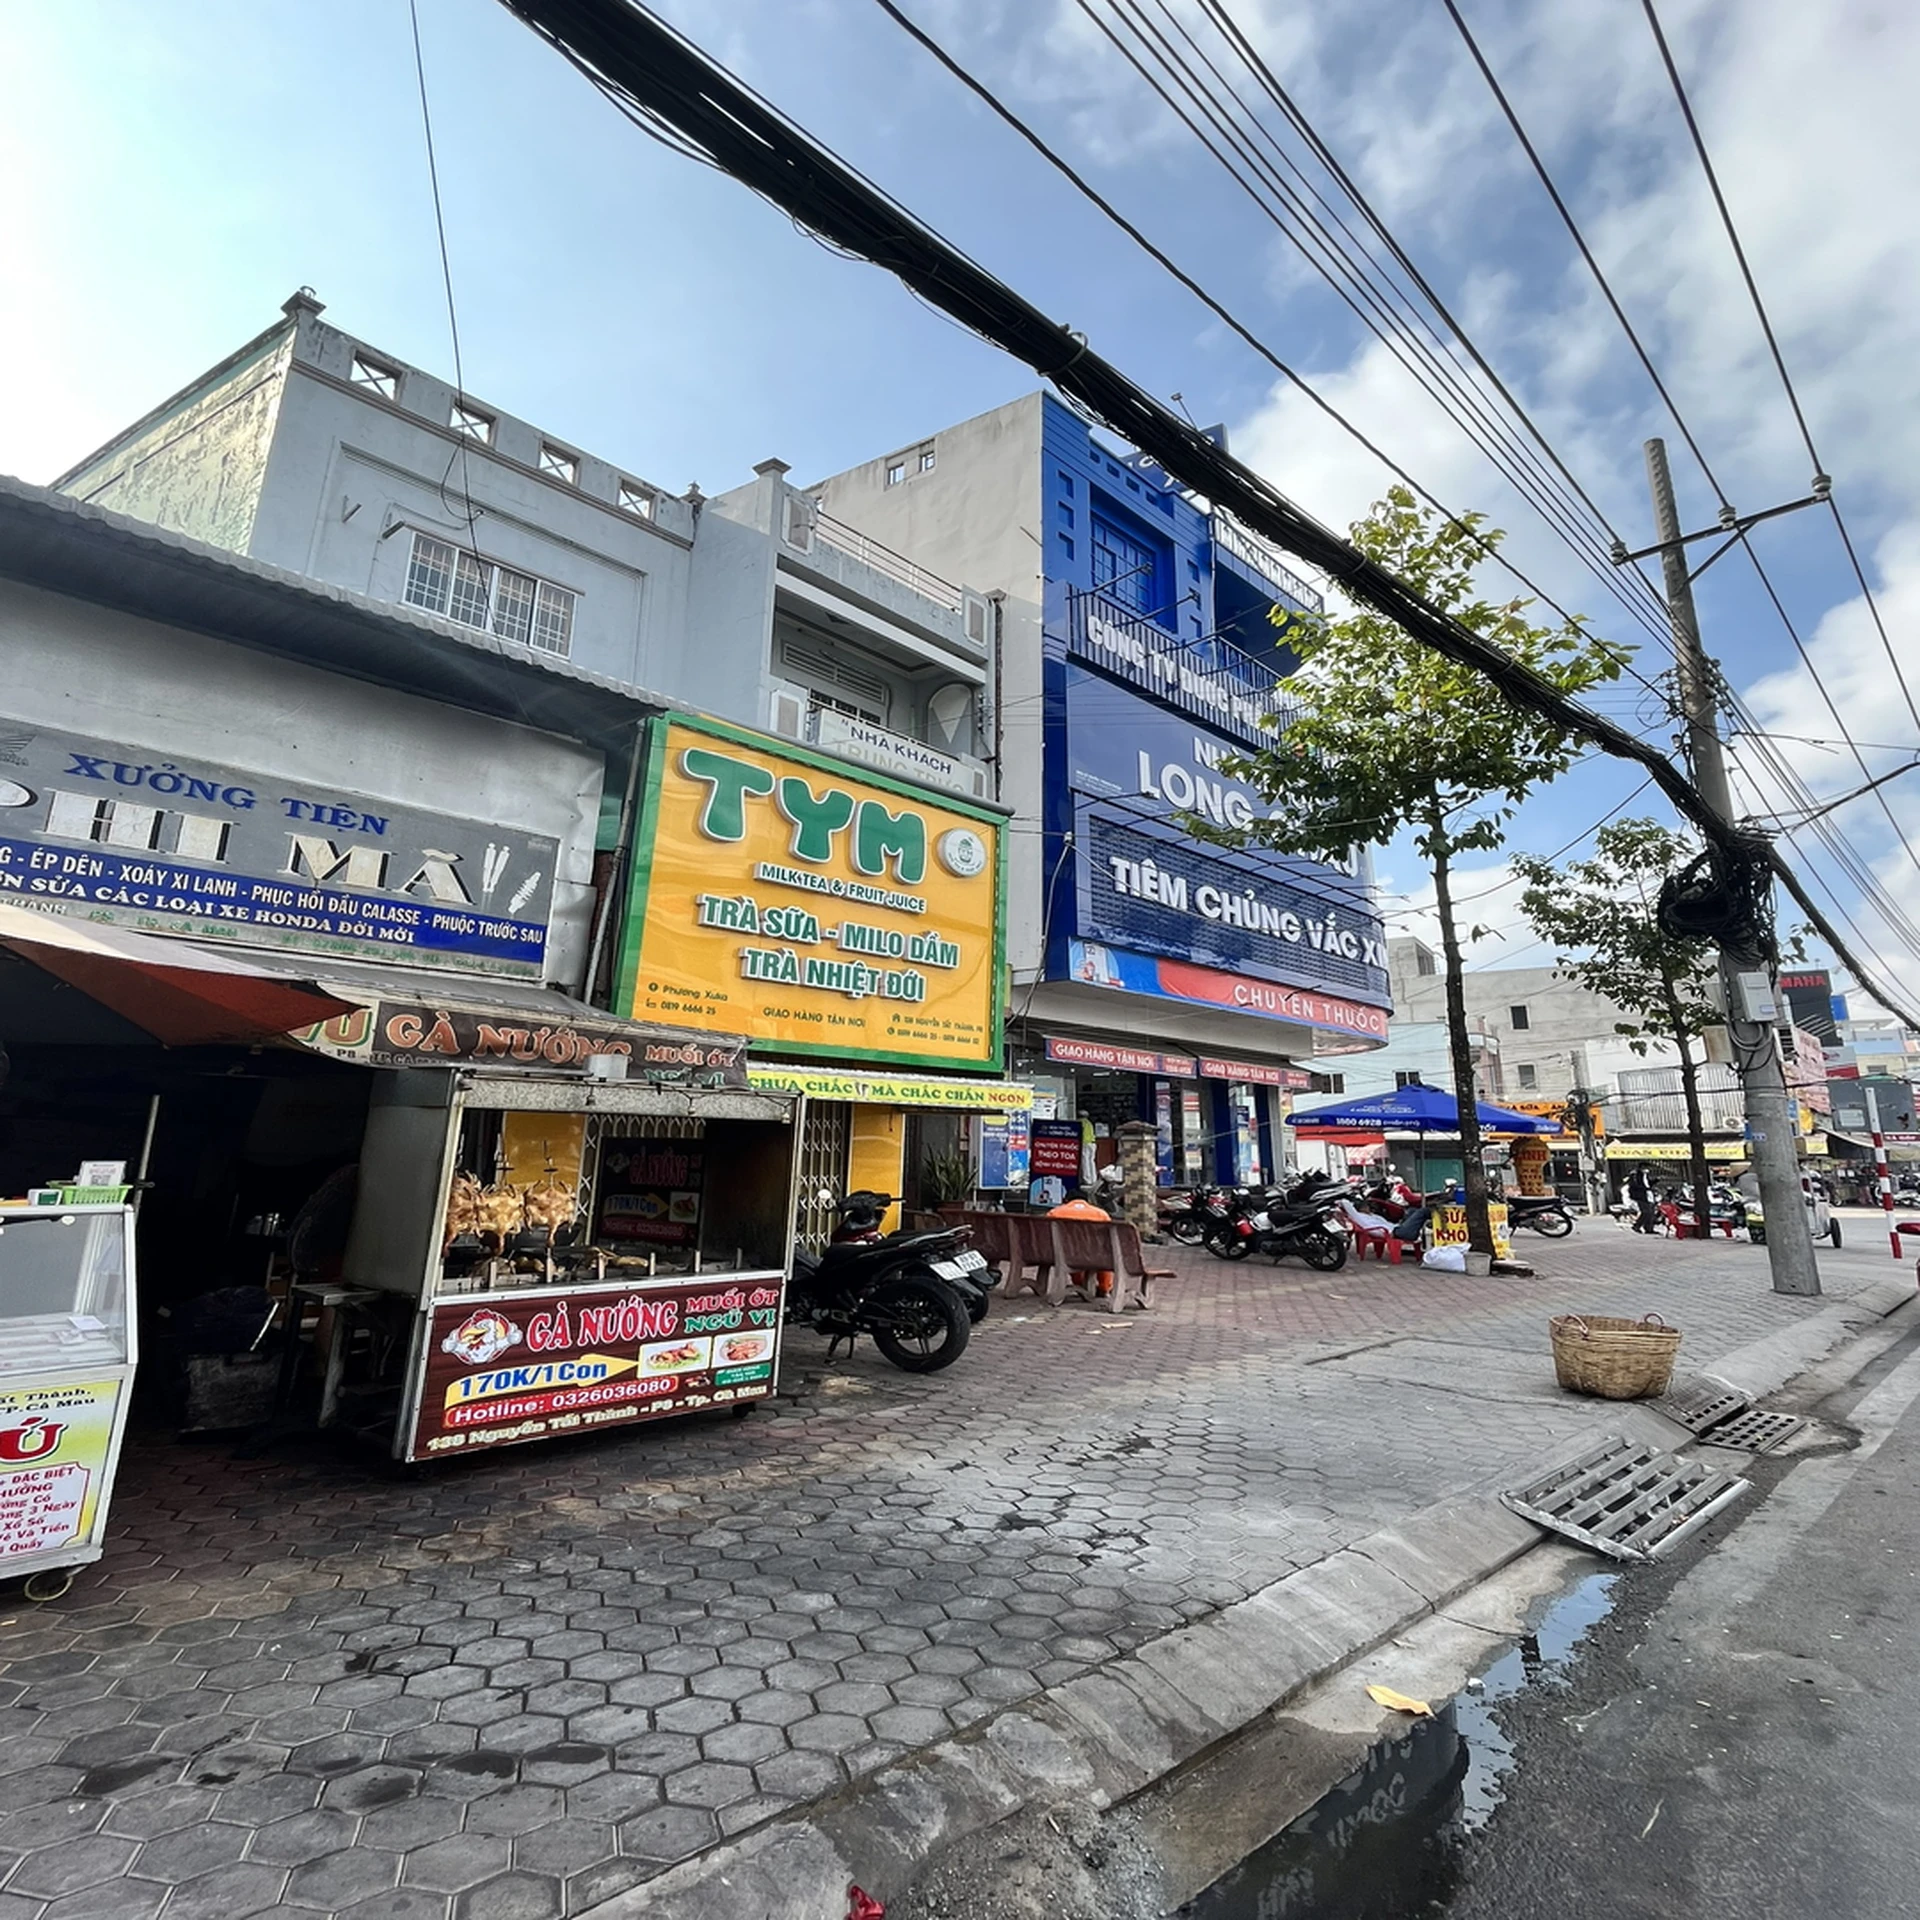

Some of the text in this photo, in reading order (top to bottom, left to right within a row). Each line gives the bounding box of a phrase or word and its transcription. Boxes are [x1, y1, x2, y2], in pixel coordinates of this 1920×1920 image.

[63, 752, 390, 835] XƯỞNG TIỆN
[680, 746, 927, 885] TYM
[1138, 749, 1254, 829] LONG
[30, 847, 58, 872] ÉP
[120, 863, 169, 887] XOÁY
[170, 872, 190, 892] XI
[193, 875, 237, 899] LANH
[251, 885, 294, 910] PHỤC
[361, 903, 420, 927] CALASSE
[432, 914, 476, 937] PHUỘC
[520, 927, 544, 944] SAU
[276, 831, 478, 906] MÃ
[832, 880, 843, 893] &
[848, 884, 886, 902] FRUIT
[887, 894, 925, 912] JUICE
[29, 874, 87, 898] SỬA
[95, 883, 150, 906] CÁC
[155, 895, 215, 918] LOẠI
[216, 904, 249, 920] XE
[254, 910, 333, 932] HONDA
[337, 920, 374, 938] ĐỜI
[379, 925, 415, 943] MỚI
[699, 892, 960, 968] TRÀ SỮA MILO DẦM
[1109, 856, 1188, 911] TIÊM
[1195, 886, 1300, 943] CHỦNG
[1304, 911, 1359, 960] VẮC
[743, 946, 926, 1001] TRÀ NHIỆT ĐỚI
[762, 1007, 791, 1019] GIAO
[793, 1010, 823, 1023] HÀNG
[827, 1013, 846, 1027] TẬN
[1233, 984, 1381, 1032] CHUYÊN THUỐC
[384, 1011, 462, 1056] GÀ
[473, 1022, 633, 1063] NƯỚNG
[644, 1043, 705, 1066] MUỐI
[1055, 1044, 1082, 1058] GIAO
[1083, 1046, 1114, 1062] HÀNG
[747, 1075, 800, 1092] CHƯA
[871, 1084, 896, 1097] MÀ
[900, 1084, 941, 1100] CHẮC
[944, 1085, 985, 1102] CHẮN
[987, 1092, 1025, 1104] NGON
[1204, 1062, 1227, 1075] GIAO
[526, 1285, 779, 1353] GÀ NƯỚNG MUỐI ỚT
[684, 1308, 776, 1334] NGŨ VỊ
[453, 1379, 672, 1423] Hotline: 0326036080
[459, 1360, 609, 1399] 170K/1Con
